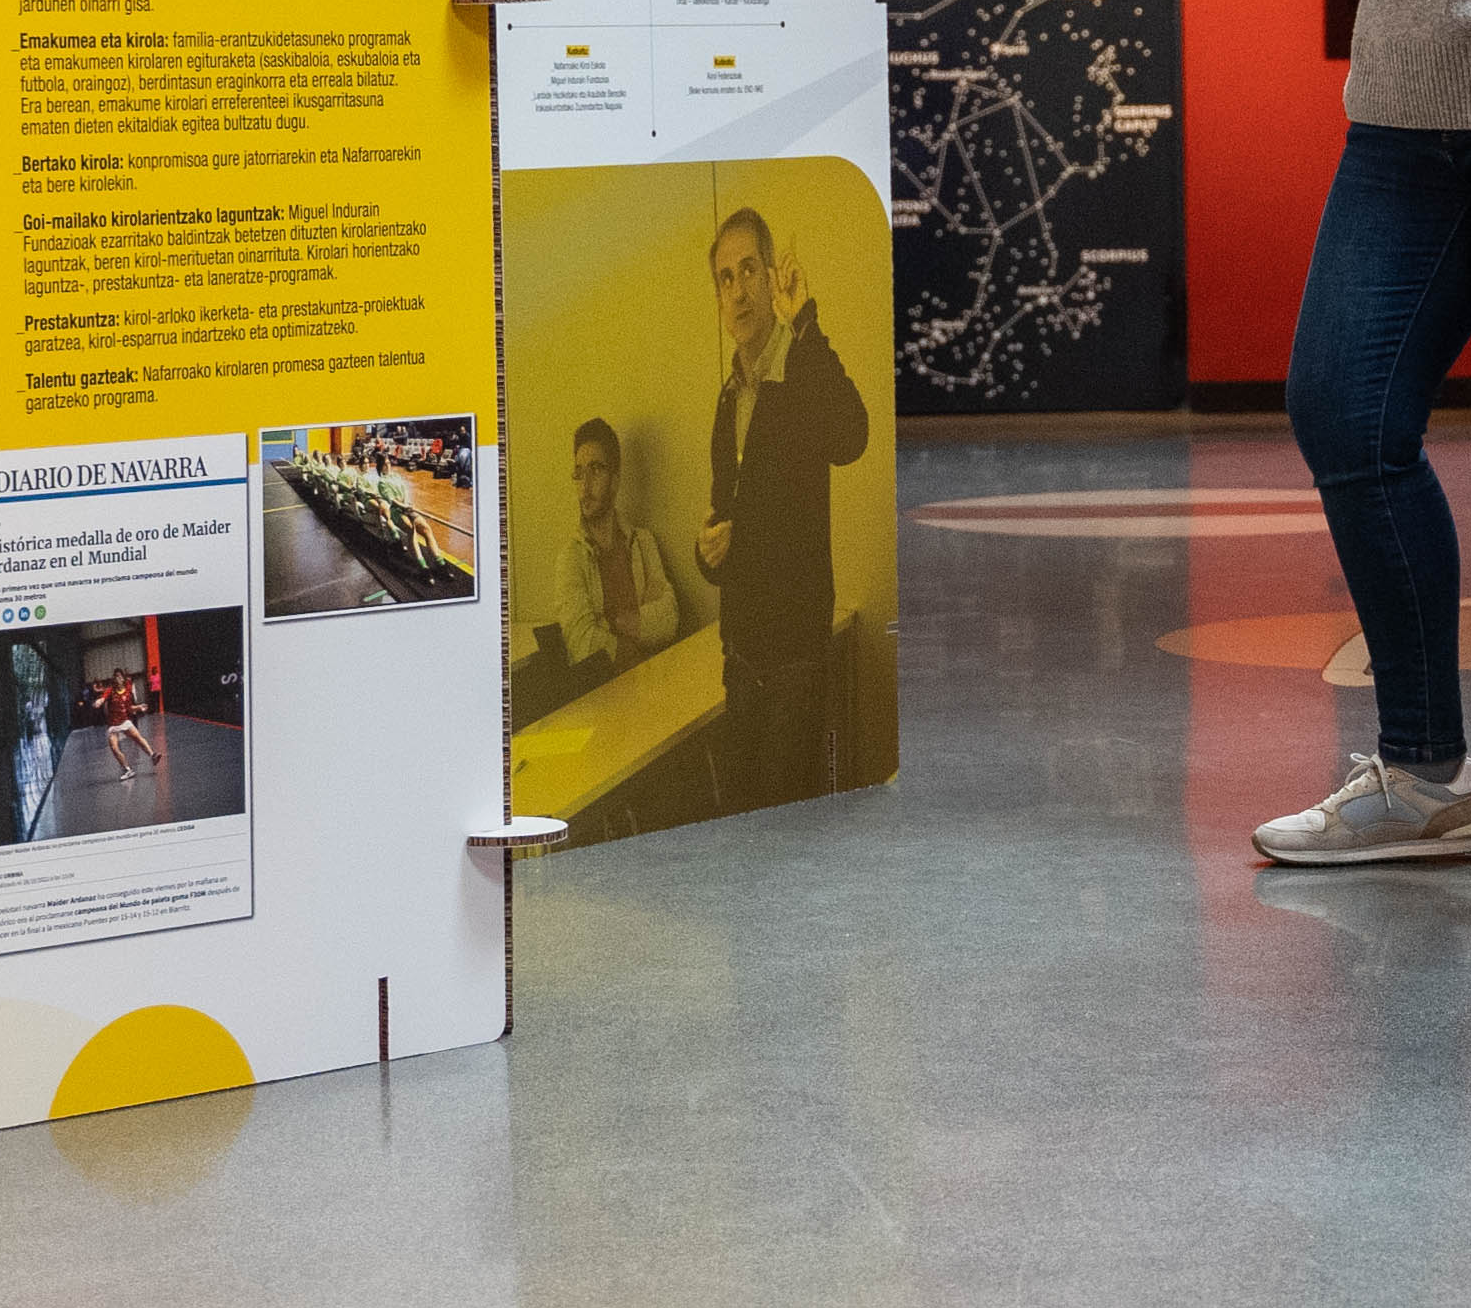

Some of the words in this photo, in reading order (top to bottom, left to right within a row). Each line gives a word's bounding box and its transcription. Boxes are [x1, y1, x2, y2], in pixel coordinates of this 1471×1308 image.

[20, 96, 42, 113] Era
[46, 96, 94, 115] berean,
[98, 94, 161, 112] emakume
[164, 93, 208, 111] kirolari
[211, 91, 290, 110] erreferenteei
[292, 90, 384, 112] ikusgarritasuna
[21, 119, 70, 135] ematen
[73, 117, 114, 134] dieten
[117, 115, 178, 133] ekitaldiak
[181, 114, 220, 136] egitea
[223, 113, 273, 131] bultzatu
[275, 113, 310, 133] dugu.
[21, 178, 43, 194] eta
[46, 176, 76, 193] bere
[79, 174, 138, 192] kirolekin.
[25, 391, 90, 415] garatzeko
[93, 390, 158, 411] programa.
[78, 463, 107, 487] DE
[111, 456, 208, 484] NAVARRA
[56, 529, 113, 548] medalla
[116, 528, 132, 544] de
[136, 528, 159, 541] oro
[163, 524, 179, 539] de
[182, 520, 231, 537] Maider
[50, 556, 67, 568] en
[71, 553, 83, 567] el
[88, 546, 147, 565] Mundial
